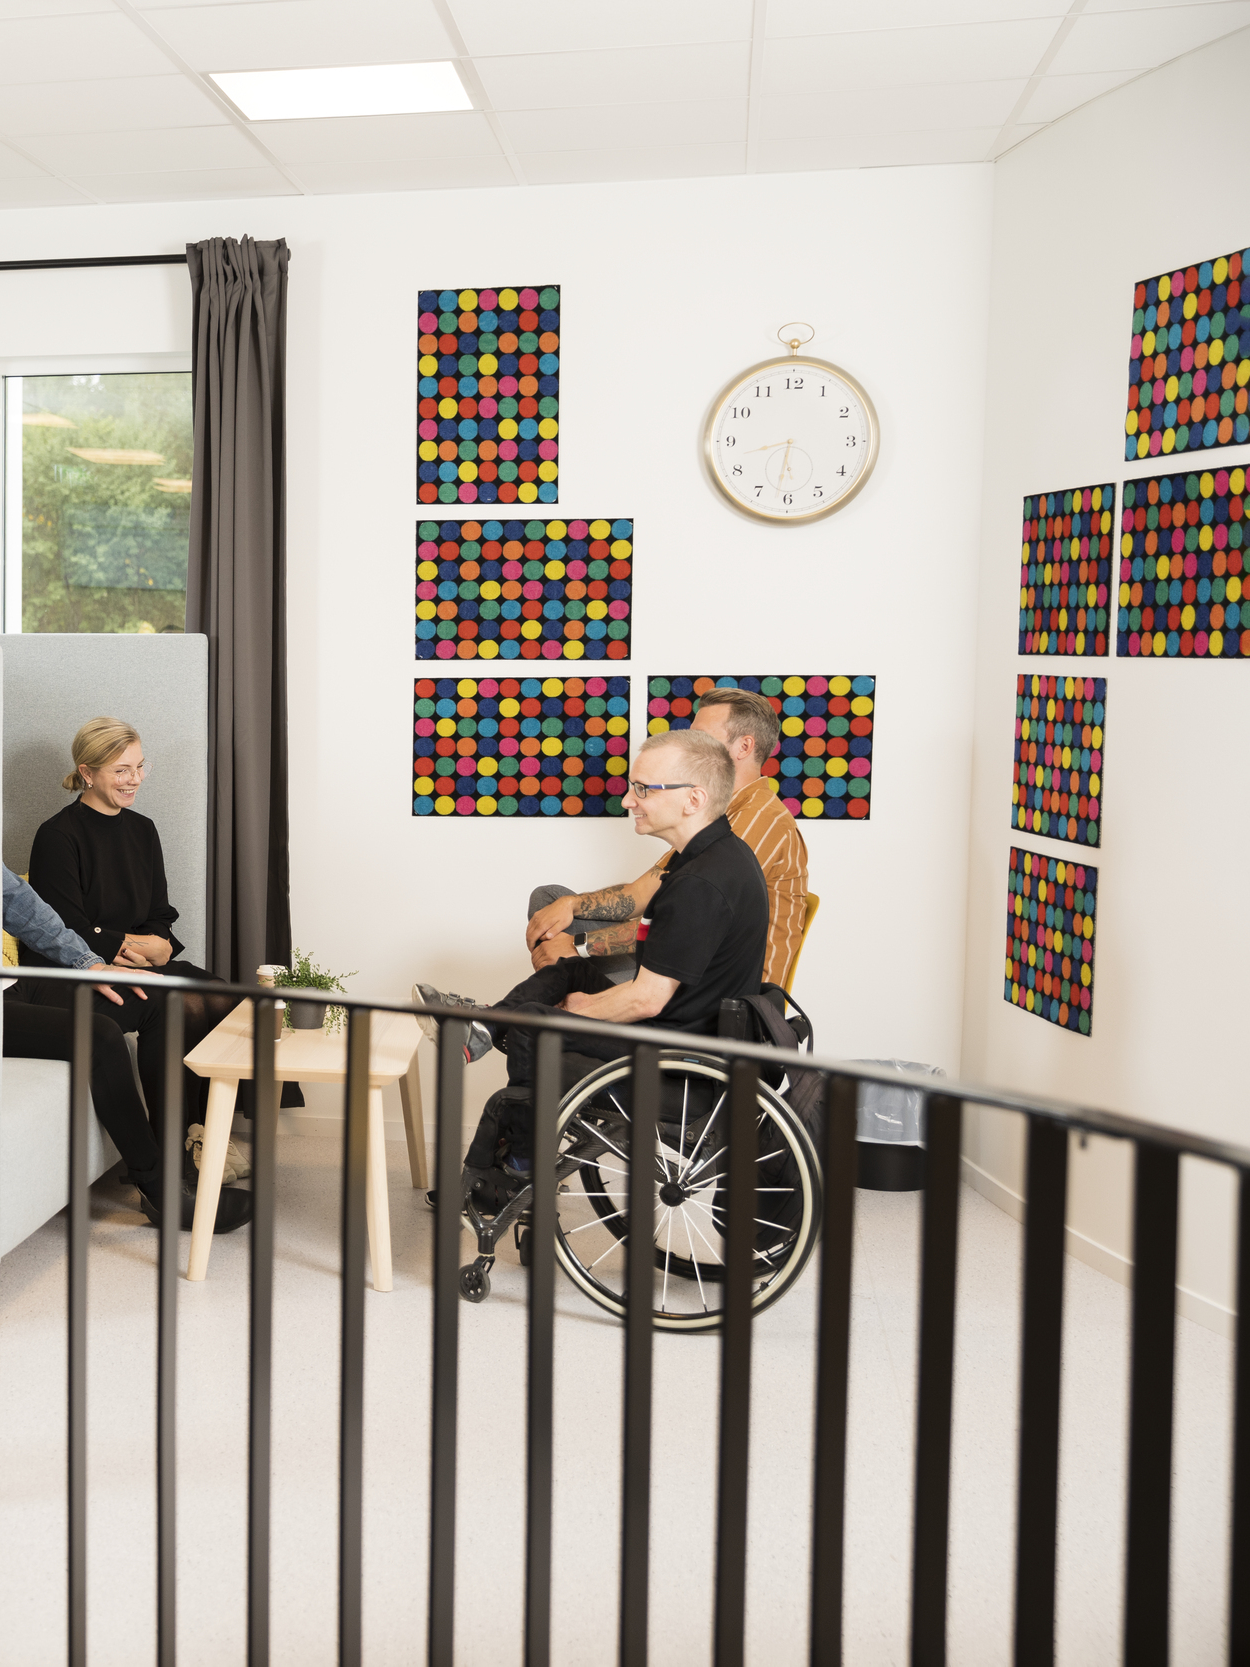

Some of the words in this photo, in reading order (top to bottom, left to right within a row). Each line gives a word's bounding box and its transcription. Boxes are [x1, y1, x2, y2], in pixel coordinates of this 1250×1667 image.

[784, 377, 804, 390] 12
[754, 385, 772, 397] 11
[820, 385, 827, 397] 1
[731, 406, 751, 419] 10
[839, 406, 849, 418] 2
[726, 435, 736, 447] 9
[846, 435, 856, 448] 3
[732, 464, 743, 476] 8
[836, 465, 847, 477] 4
[754, 485, 764, 497] 7
[812, 485, 823, 498] 5
[782, 493, 793, 505] 6
